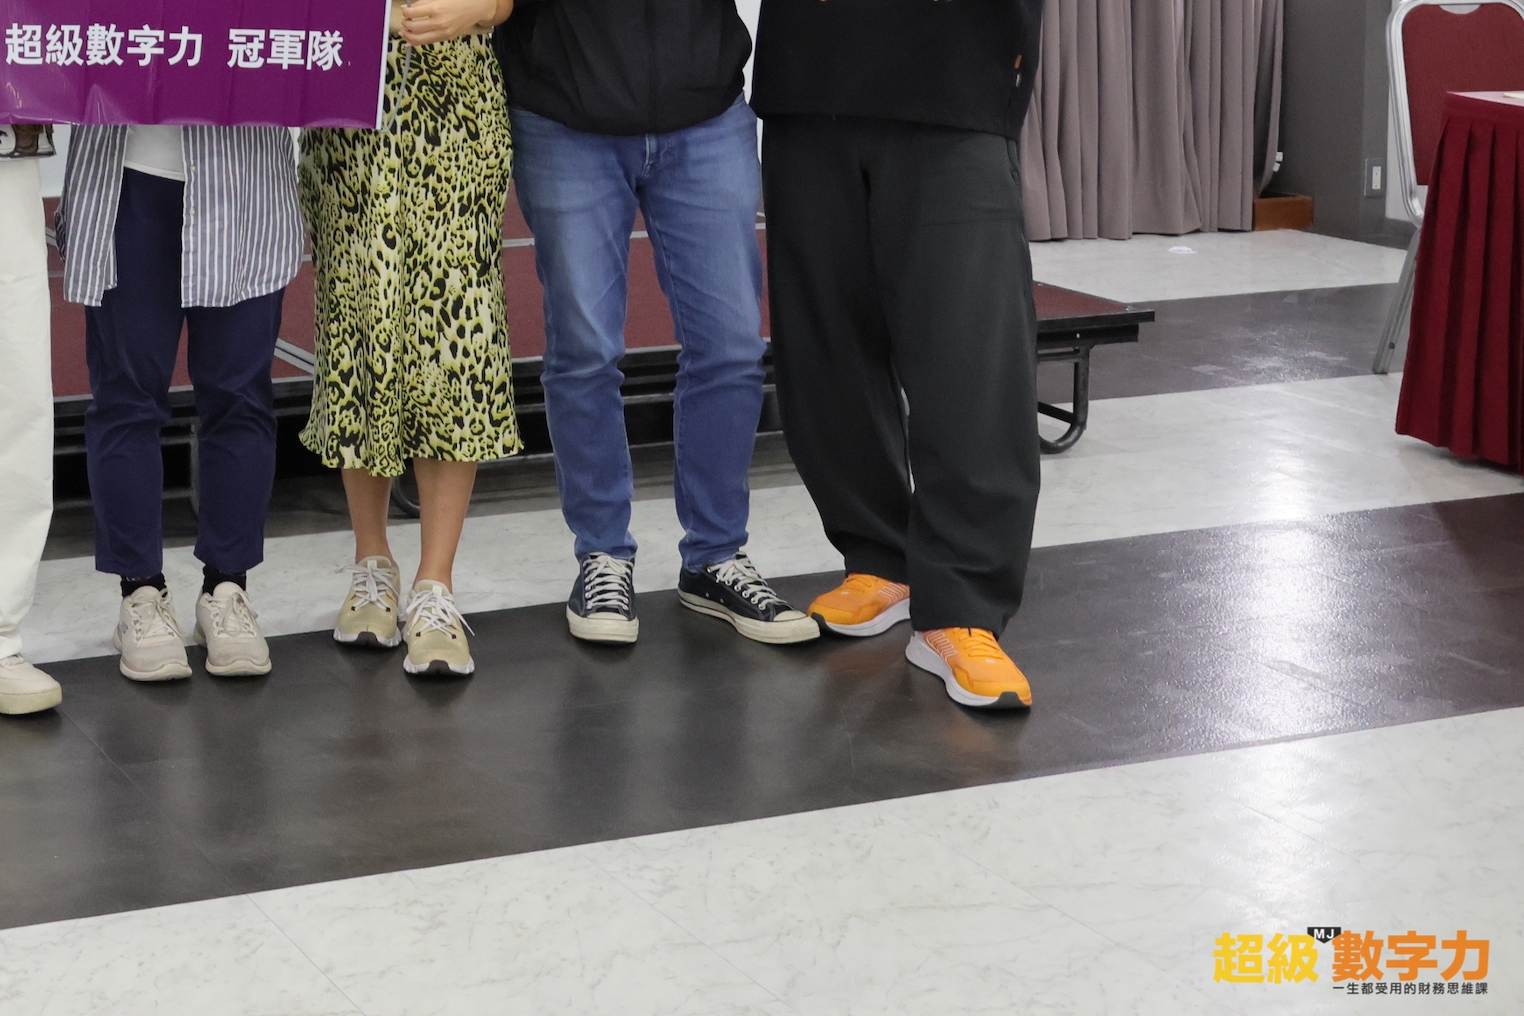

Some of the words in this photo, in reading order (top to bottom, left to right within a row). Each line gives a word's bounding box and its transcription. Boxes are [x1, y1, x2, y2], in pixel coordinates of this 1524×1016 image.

[5, 23, 203, 67] 超級數字力
[228, 28, 343, 71] 冠軍隊
